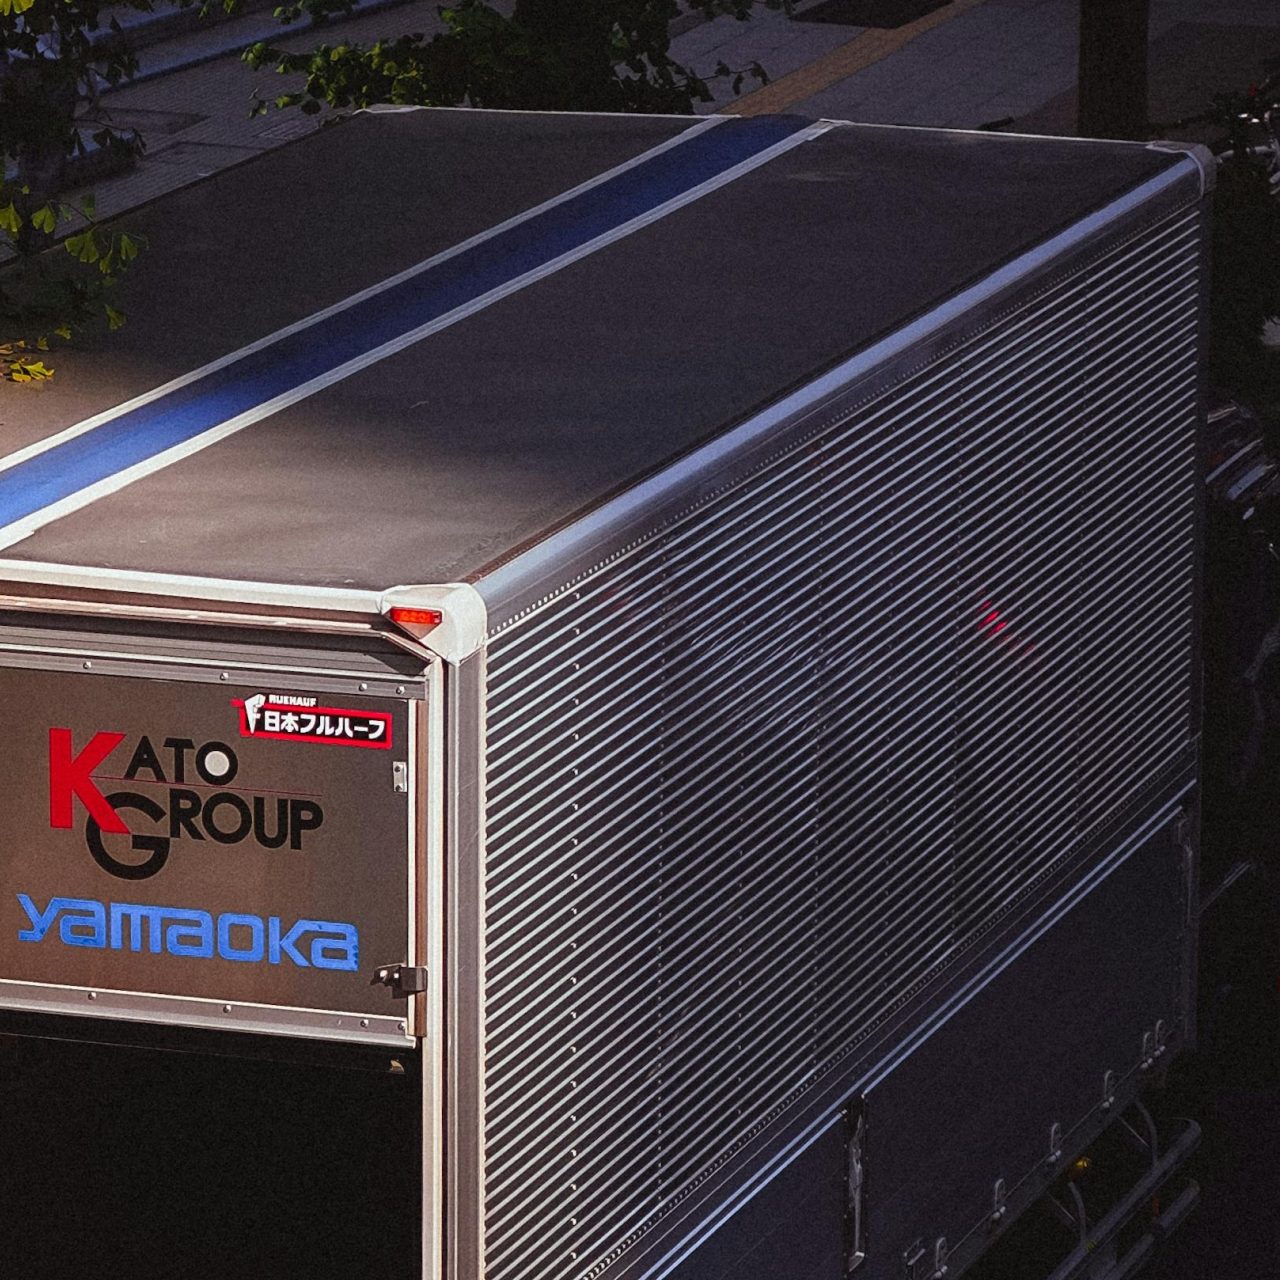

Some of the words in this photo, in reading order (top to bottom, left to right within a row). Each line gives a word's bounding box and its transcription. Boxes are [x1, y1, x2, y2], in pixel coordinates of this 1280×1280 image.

[264, 711, 385, 739] 日本フルハーフ
[49, 727, 239, 834] KATO
[85, 790, 324, 880] GROUP
[16, 893, 359, 972] yamaoka
